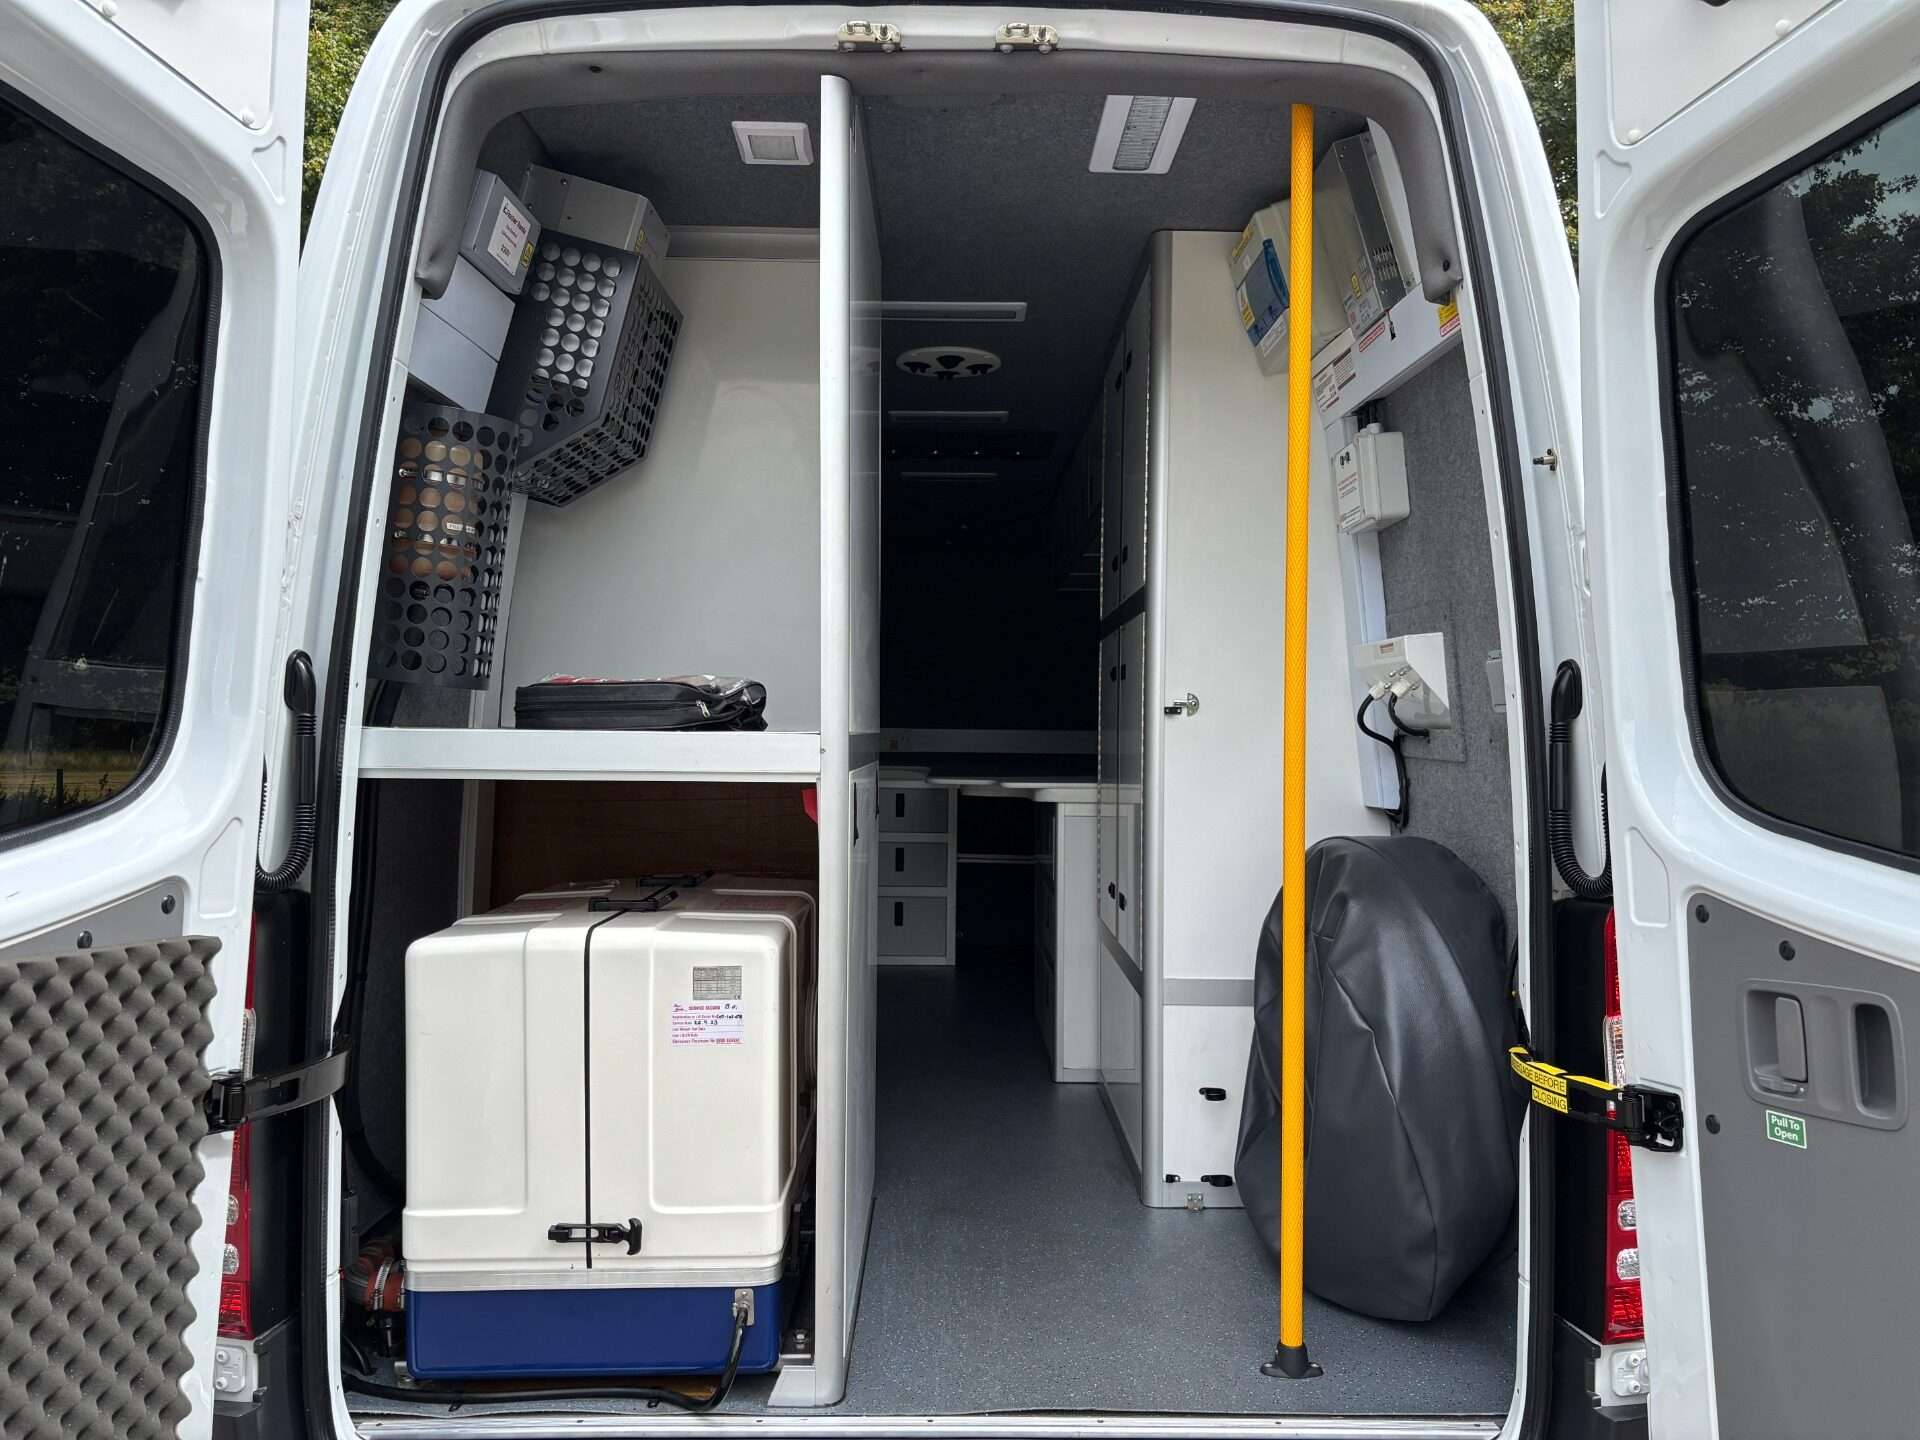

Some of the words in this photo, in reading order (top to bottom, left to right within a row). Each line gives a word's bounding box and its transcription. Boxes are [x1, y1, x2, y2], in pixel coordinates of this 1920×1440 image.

[1534, 1070, 1566, 1092] BEFORE
[1533, 1088, 1567, 1110] CLOSING
[1771, 1115, 1788, 1128] Pull
[1788, 1119, 1800, 1131] To
[1774, 1127, 1799, 1142] Open
